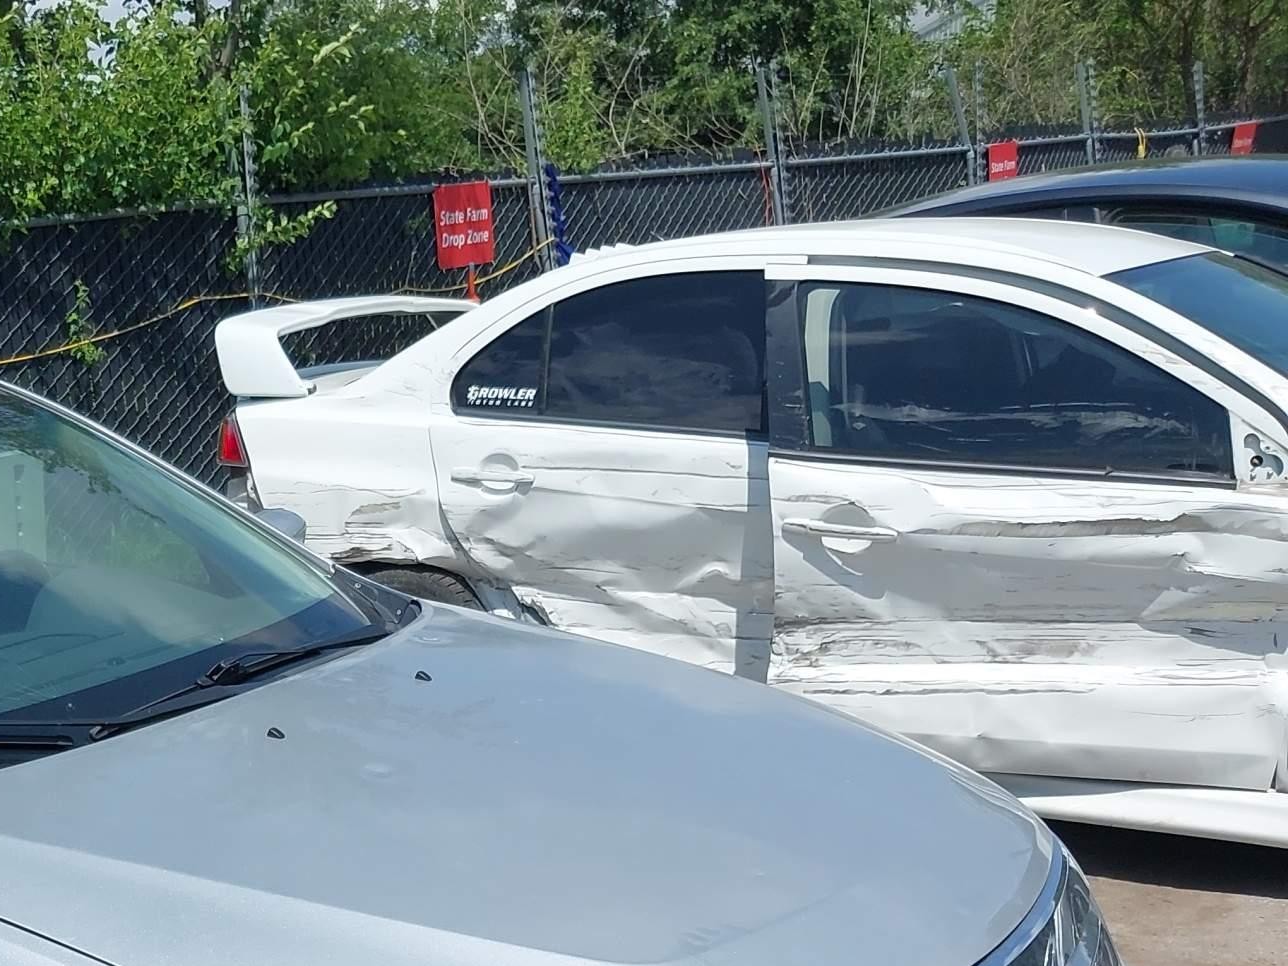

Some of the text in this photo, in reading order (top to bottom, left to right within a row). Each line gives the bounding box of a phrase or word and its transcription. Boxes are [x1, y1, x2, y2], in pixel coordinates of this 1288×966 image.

[440, 208, 488, 226] State Farm
[442, 230, 489, 249] Drop Zone
[467, 385, 537, 401] GROWLER
